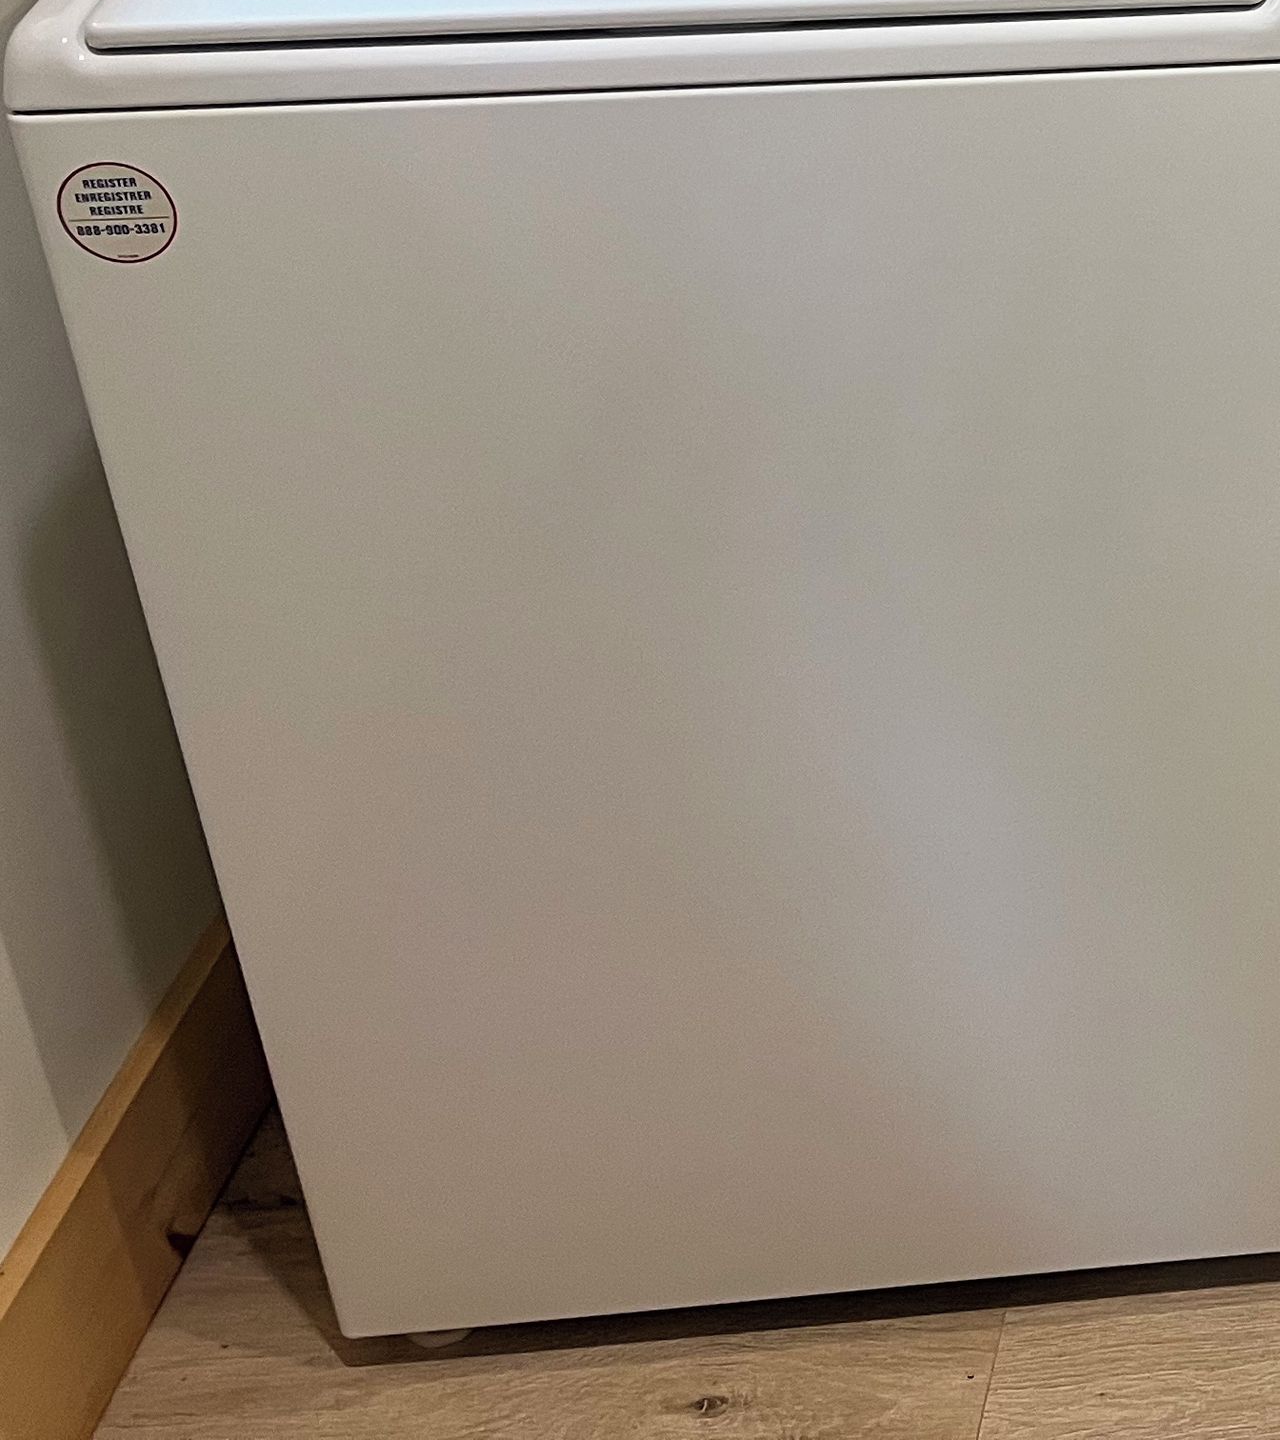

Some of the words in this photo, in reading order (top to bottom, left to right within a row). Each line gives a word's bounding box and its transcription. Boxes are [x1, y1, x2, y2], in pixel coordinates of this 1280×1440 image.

[82, 177, 138, 190] REGISTER
[74, 190, 152, 203] ENREGISTRER
[89, 204, 145, 216] REGISTRE
